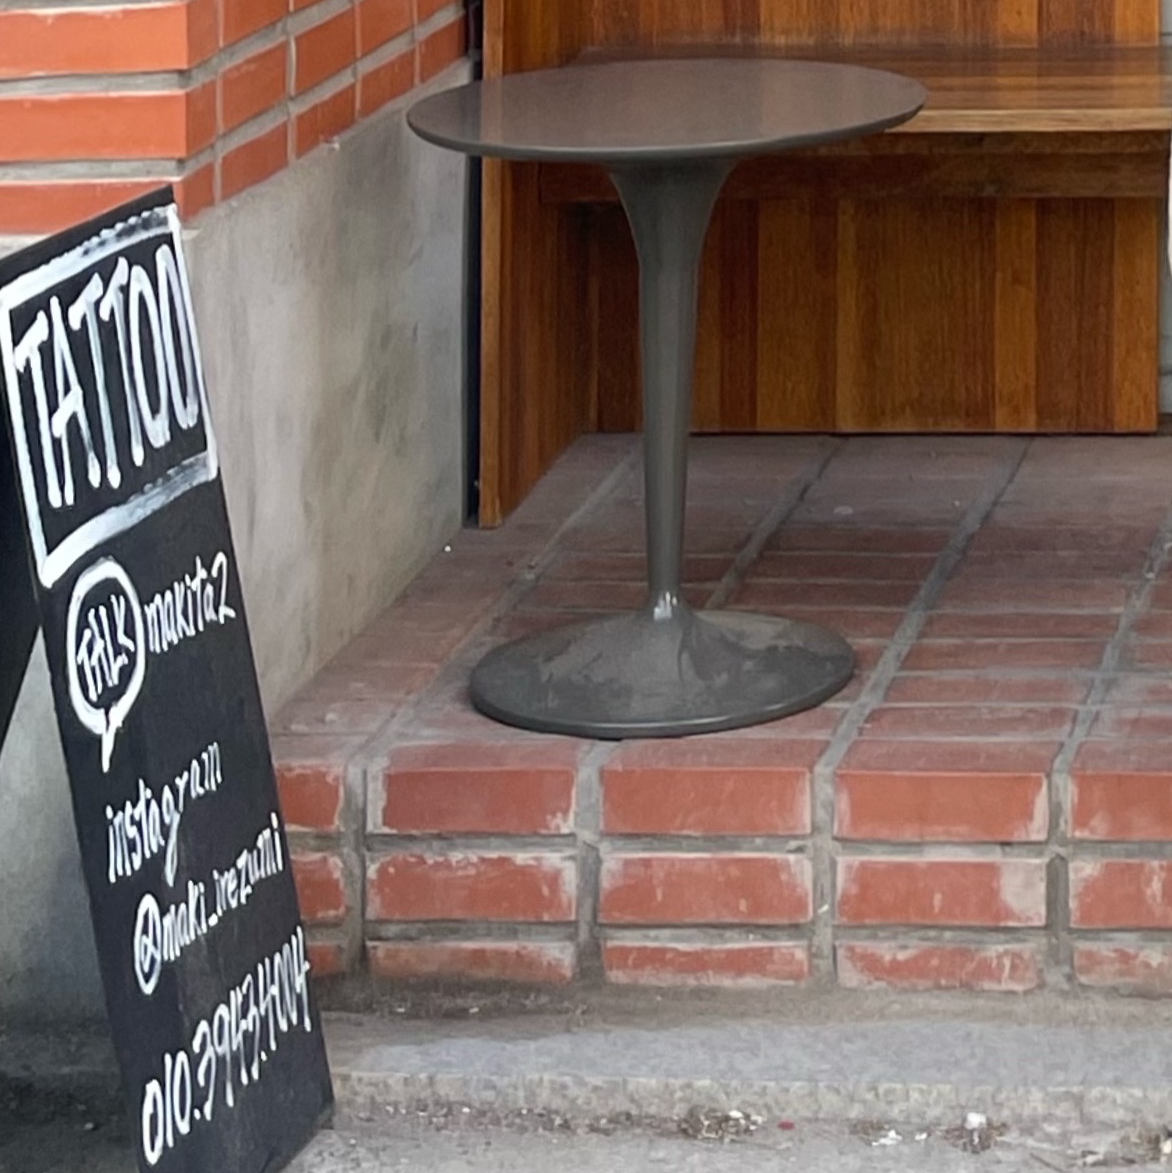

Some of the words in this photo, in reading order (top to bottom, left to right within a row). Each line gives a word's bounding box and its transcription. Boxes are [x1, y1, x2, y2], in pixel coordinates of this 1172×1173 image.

[14, 243, 199, 508] TATTOO
[76, 594, 135, 702] TALK
[144, 551, 236, 654] makita2
[106, 741, 222, 887] instagram
